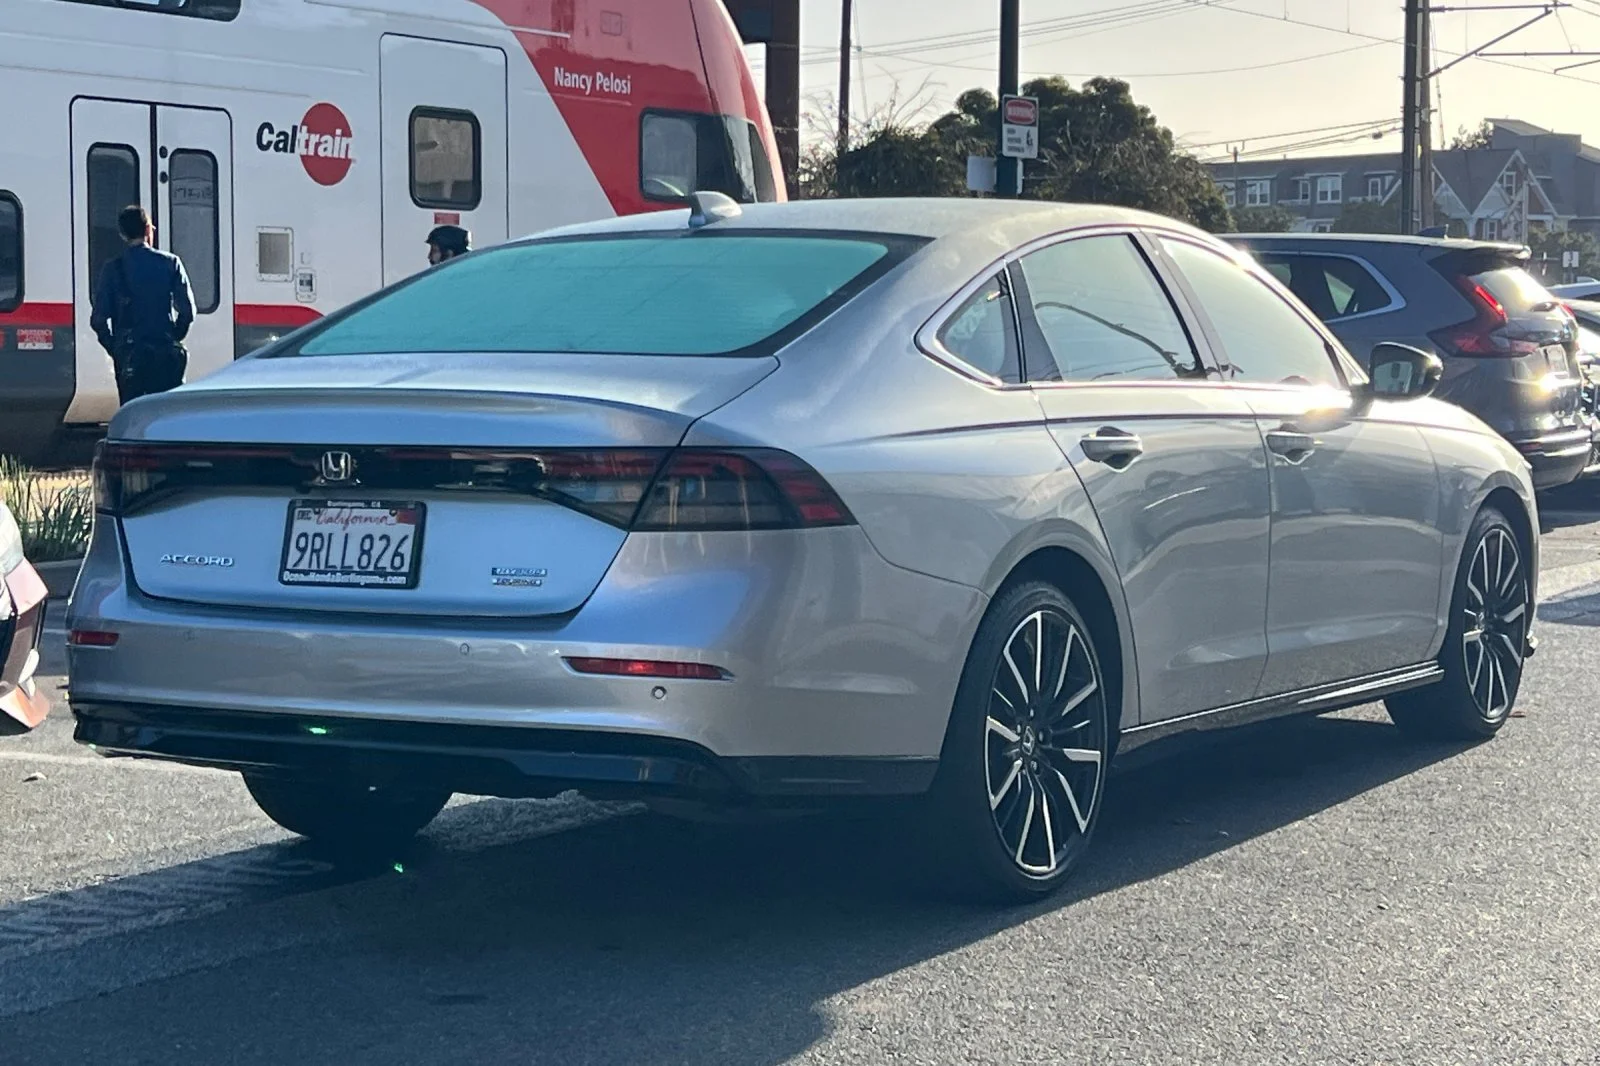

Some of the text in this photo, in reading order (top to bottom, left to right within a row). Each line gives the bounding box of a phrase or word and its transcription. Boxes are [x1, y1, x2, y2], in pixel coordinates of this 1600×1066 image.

[554, 66, 632, 96] Nancy Pelosi
[256, 121, 353, 159] Caltrain
[316, 507, 397, 531] California
[160, 554, 234, 567] ACCORD
[292, 532, 409, 571] 9RLL826
